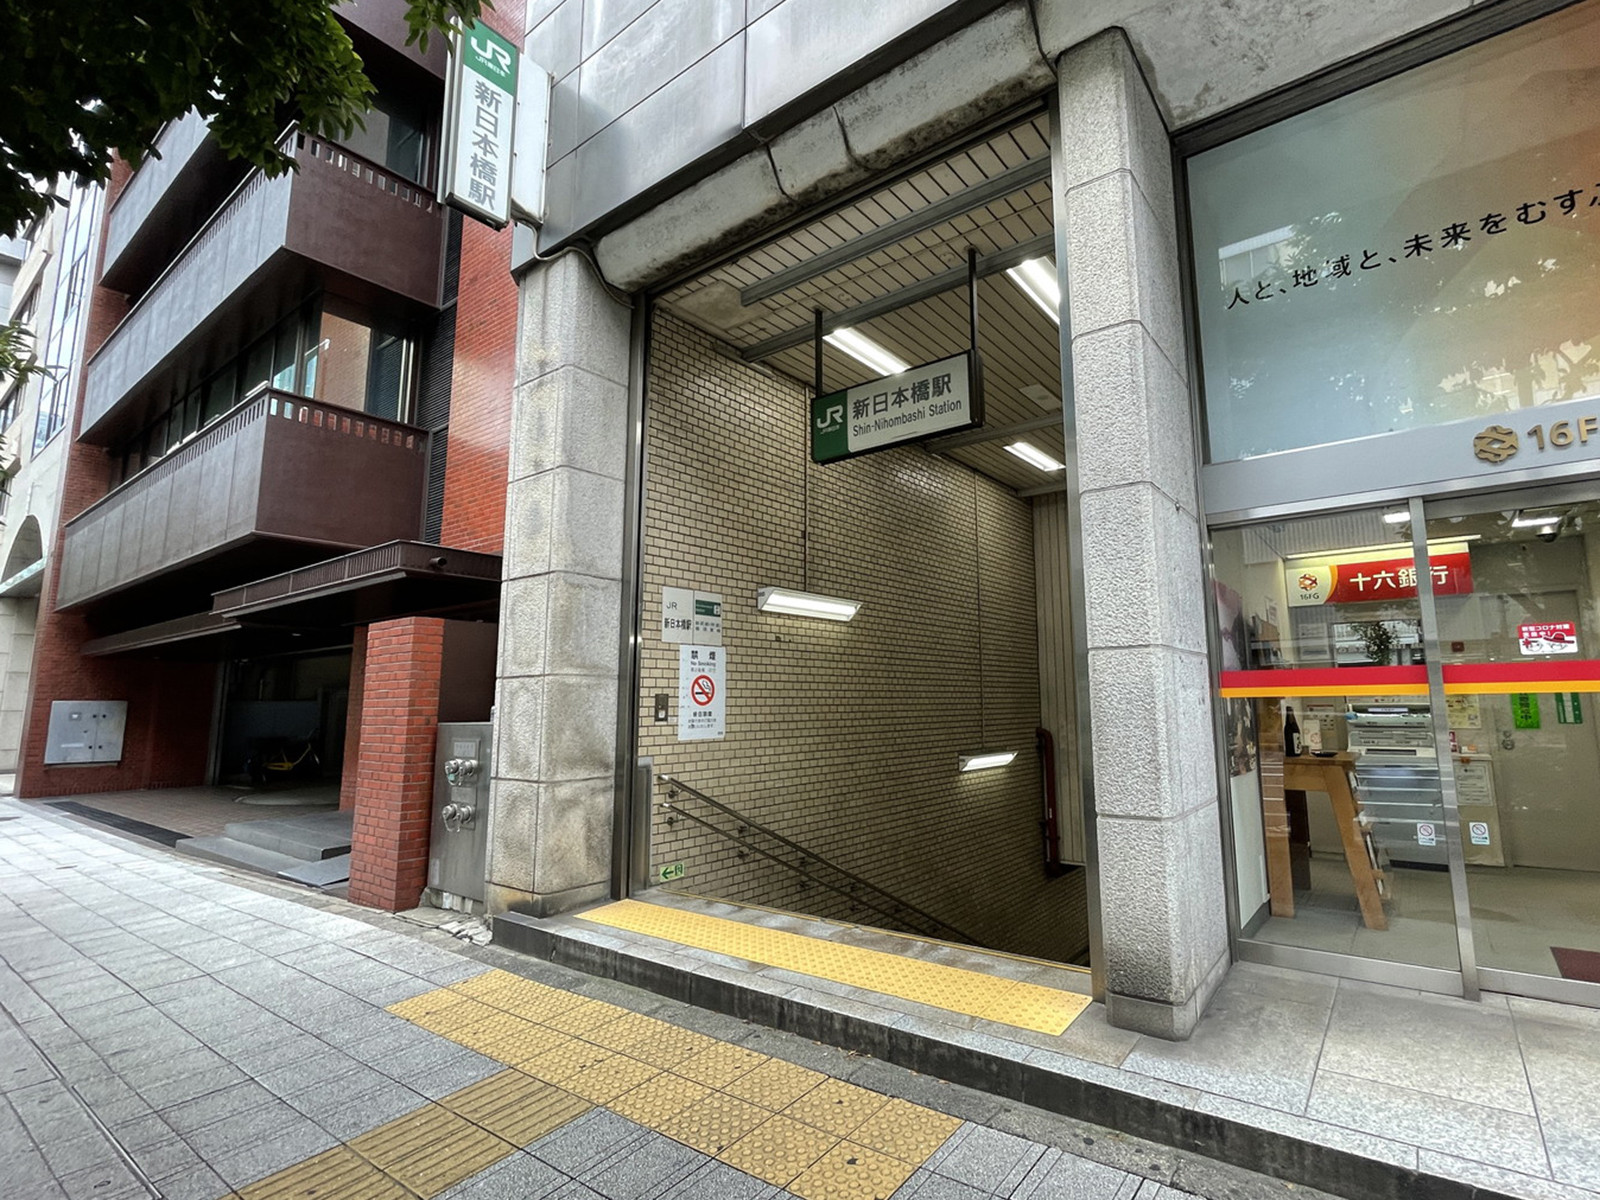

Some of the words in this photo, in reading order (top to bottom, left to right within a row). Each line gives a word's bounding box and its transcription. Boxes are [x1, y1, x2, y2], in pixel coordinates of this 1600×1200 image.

[470, 36, 511, 75] JR
[468, 80, 502, 211] 新日本橋駅
[853, 373, 952, 421] 新日本橋駅
[816, 404, 844, 429] JR
[853, 407, 926, 437] Shin-Nihombashi
[929, 400, 962, 417] Station
[1350, 565, 1449, 592] 十六銀行
[666, 601, 678, 610] JR
